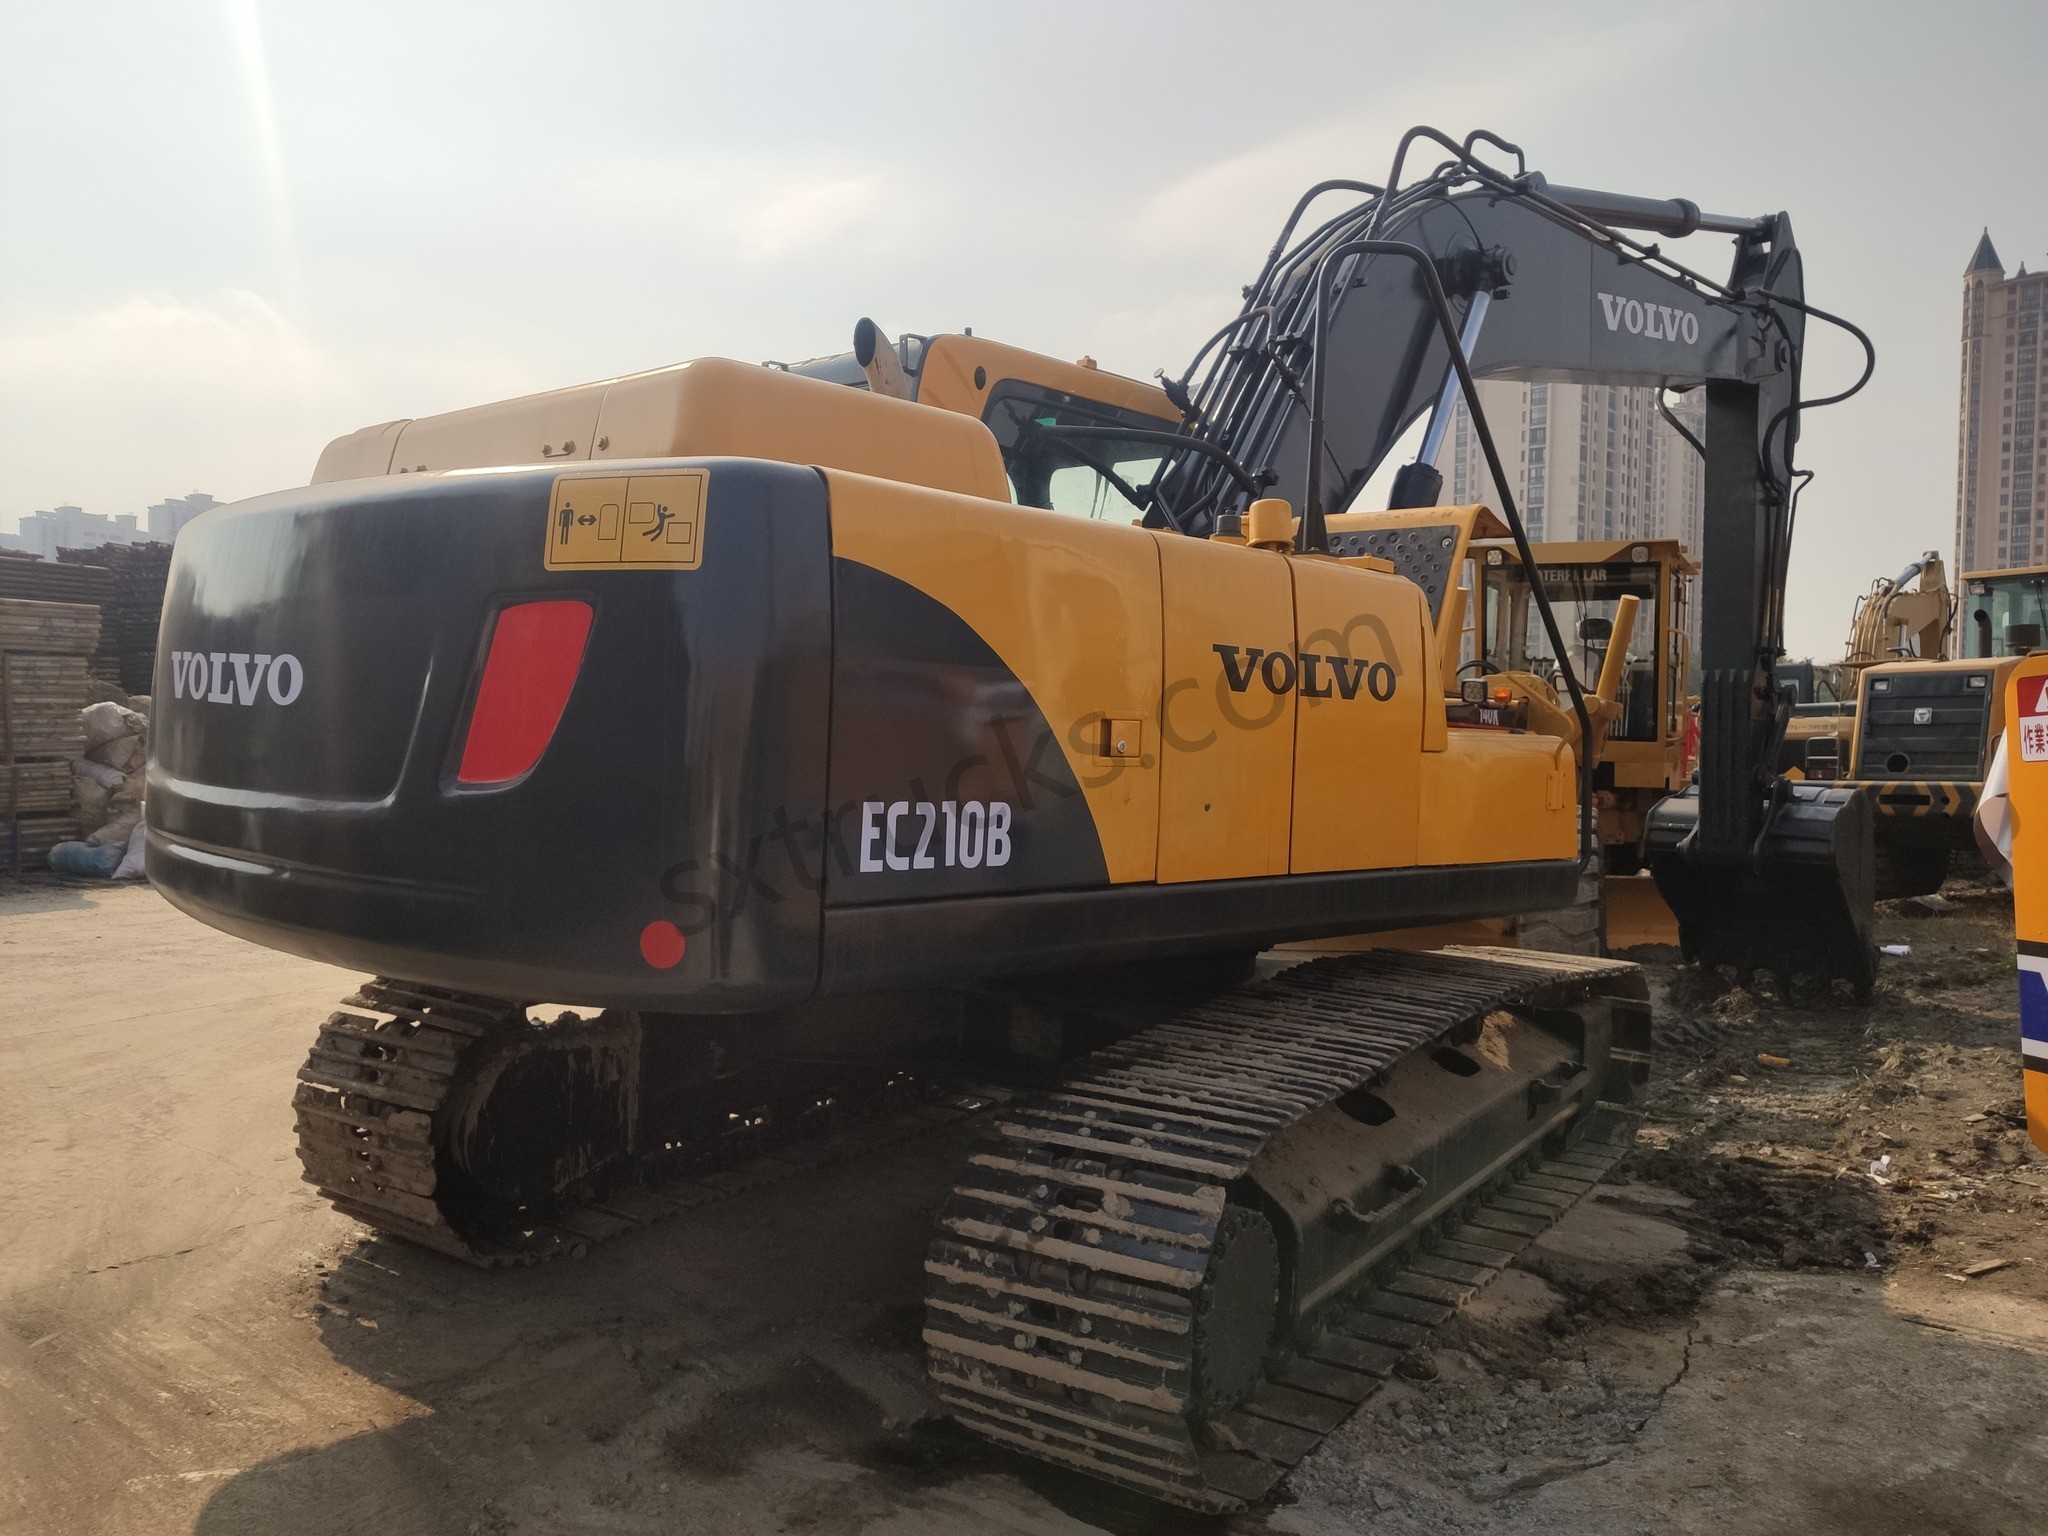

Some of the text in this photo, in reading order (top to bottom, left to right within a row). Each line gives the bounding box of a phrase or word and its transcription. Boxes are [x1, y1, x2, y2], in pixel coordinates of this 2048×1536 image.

[1597, 292, 1699, 345] VOLVO
[172, 651, 304, 706] VOLVO
[1213, 644, 1397, 702] VOLVO
[2023, 723, 2048, 755] 作業
[860, 800, 1012, 873] EC210B
